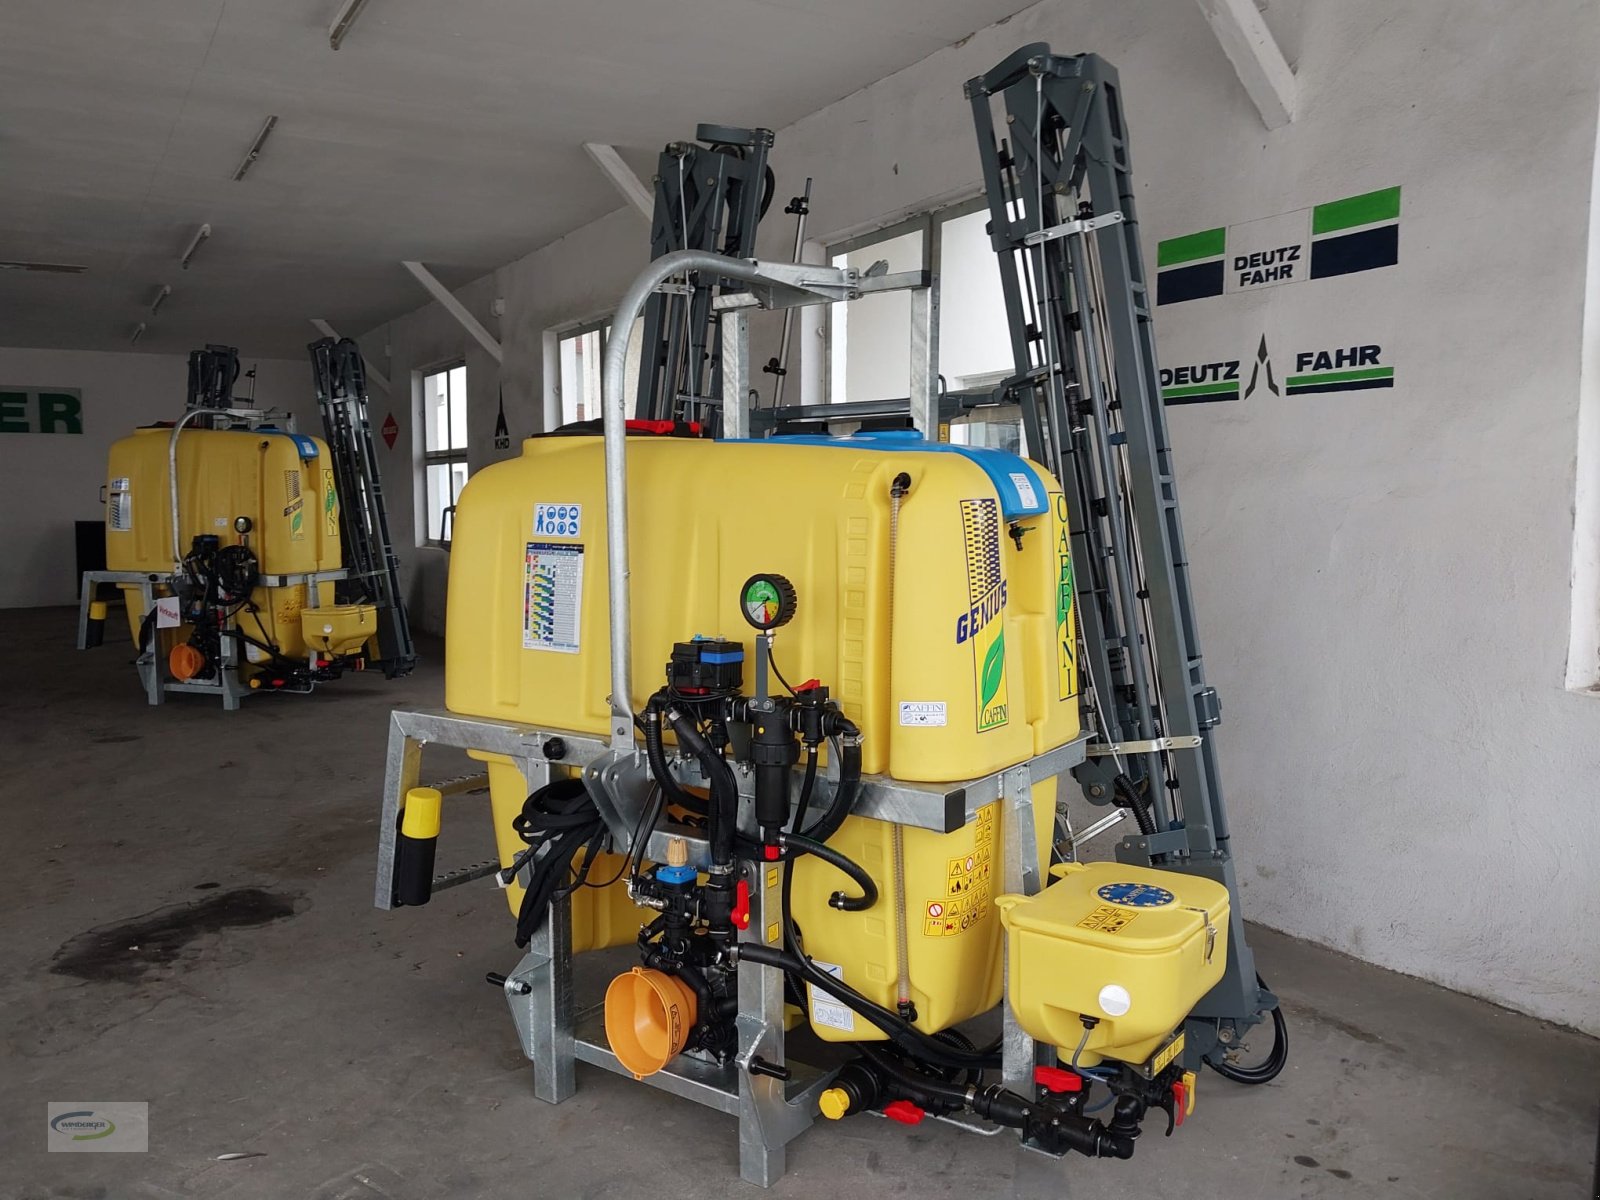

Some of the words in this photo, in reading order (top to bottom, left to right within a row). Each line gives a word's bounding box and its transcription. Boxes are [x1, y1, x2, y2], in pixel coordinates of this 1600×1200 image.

[1234, 245, 1301, 271] DEUTZ
[1239, 264, 1293, 287] FAHR
[1160, 360, 1240, 386] DEUTZ
[1296, 344, 1381, 372] FAHR
[495, 438, 510, 450] KHD
[1057, 495, 1073, 695] CAFFINI
[956, 579, 1008, 645] GENIUS
[909, 704, 944, 712] CAFFINI
[984, 705, 1007, 725] CAFFINI
